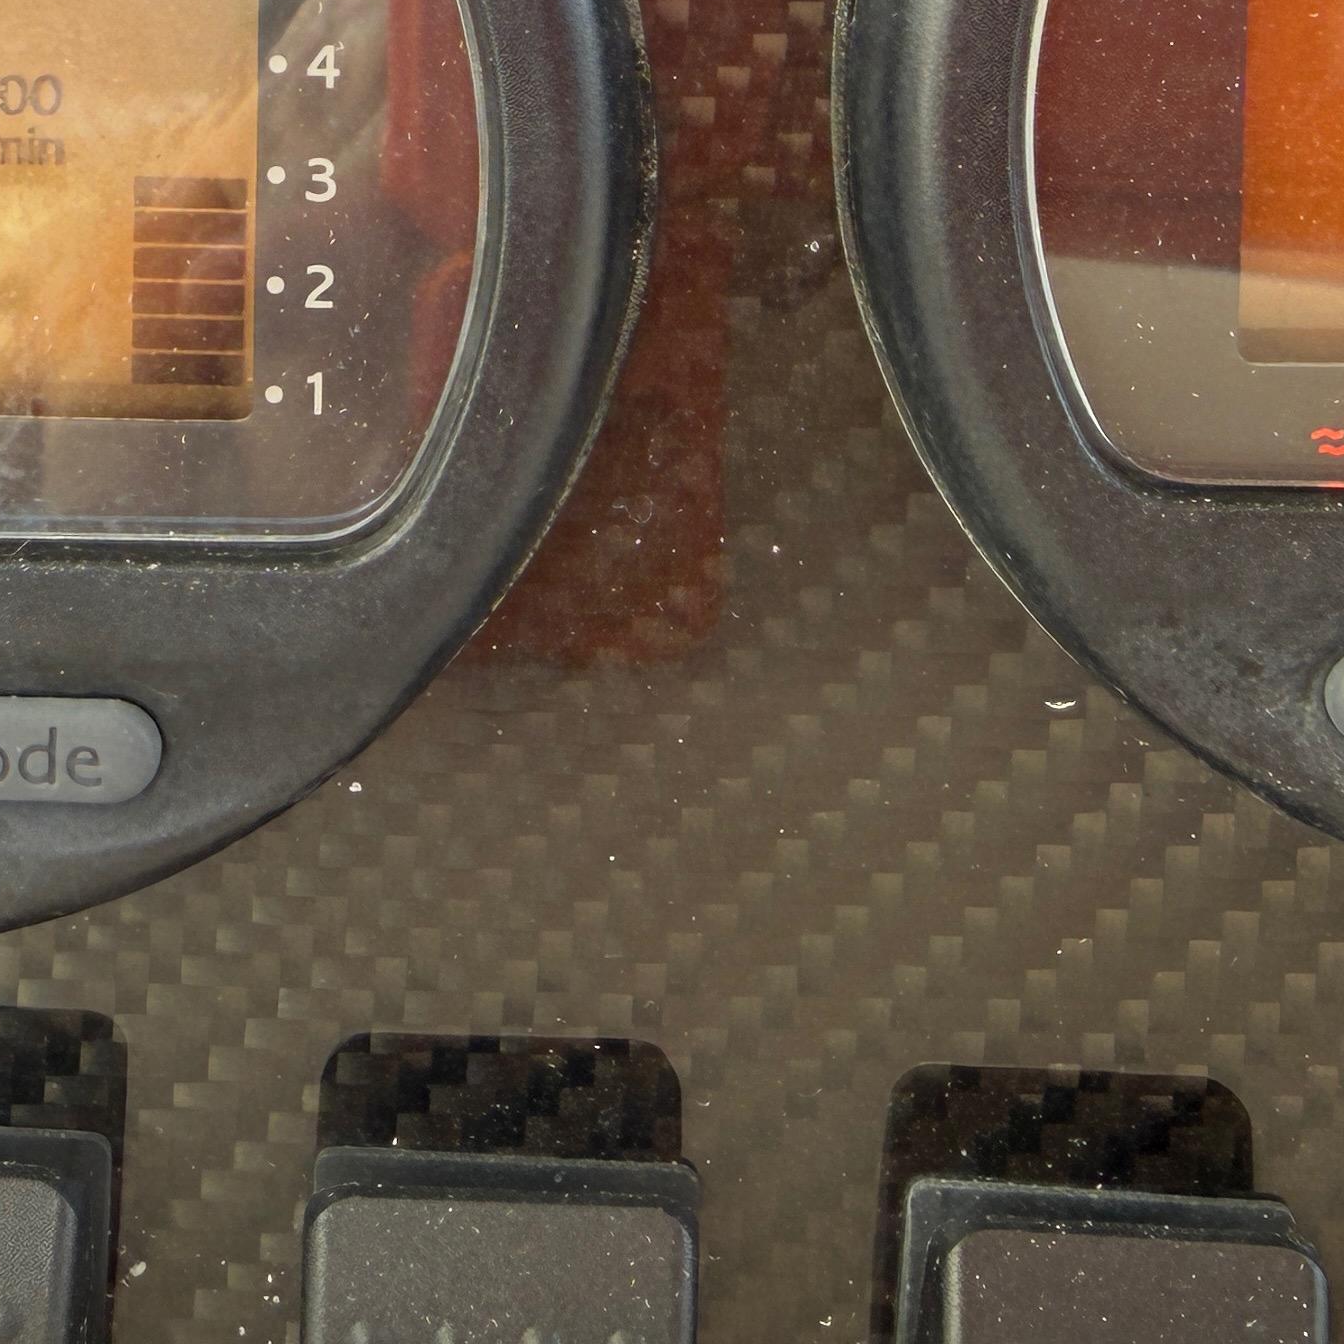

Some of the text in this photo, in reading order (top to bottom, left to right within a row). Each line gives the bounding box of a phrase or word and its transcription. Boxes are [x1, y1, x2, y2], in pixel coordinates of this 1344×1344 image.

[305, 44, 341, 89] 4
[303, 158, 337, 202] 3
[303, 264, 336, 310] 2
[304, 372, 325, 415] 1
